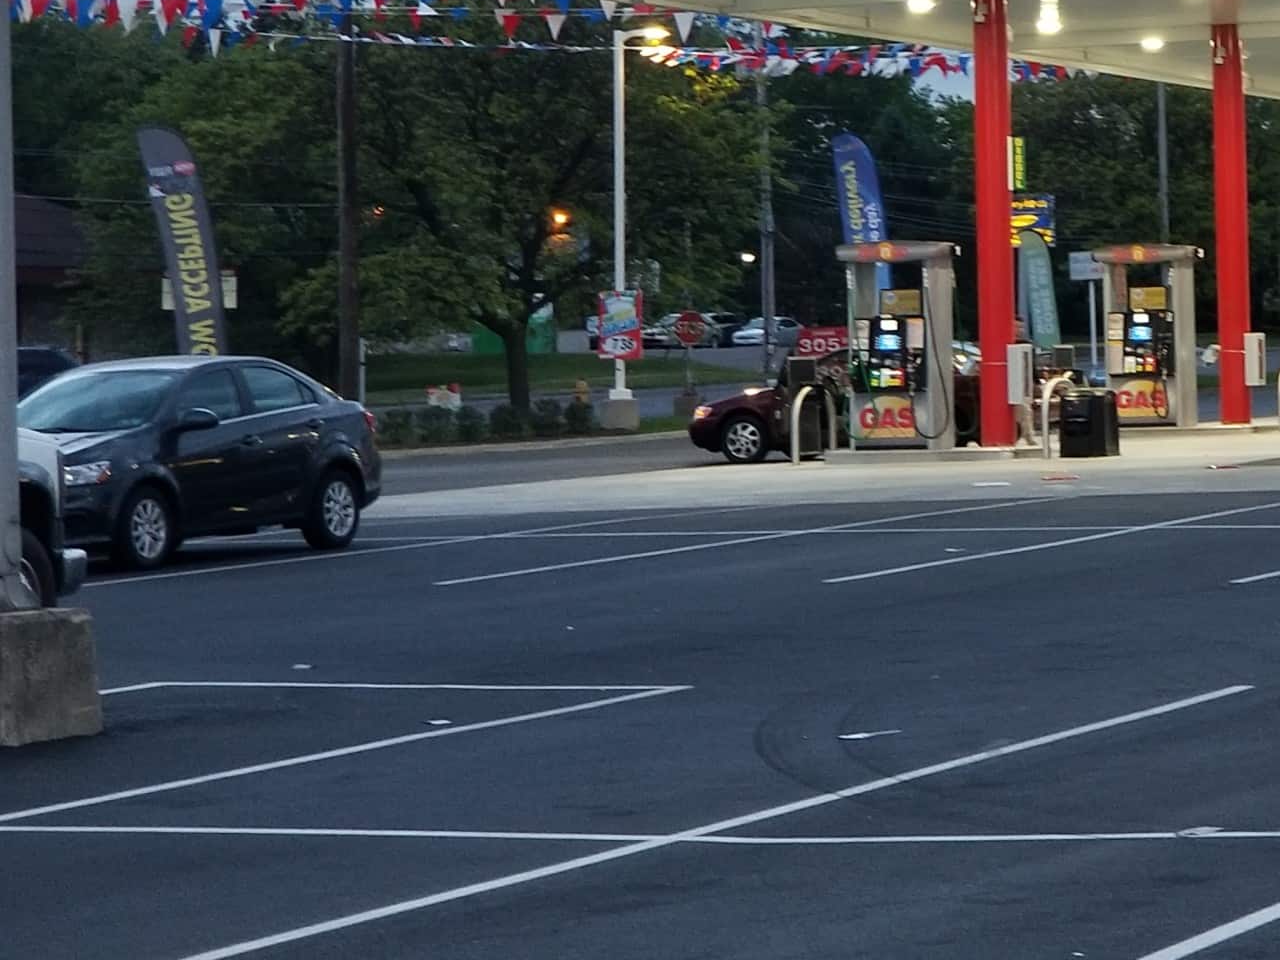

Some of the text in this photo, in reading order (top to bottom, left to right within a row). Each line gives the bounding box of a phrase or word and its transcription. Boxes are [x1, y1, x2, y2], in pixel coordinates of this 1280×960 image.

[799, 338, 840, 353] 305
[1116, 391, 1168, 409] GAS
[860, 407, 914, 429] GAS
